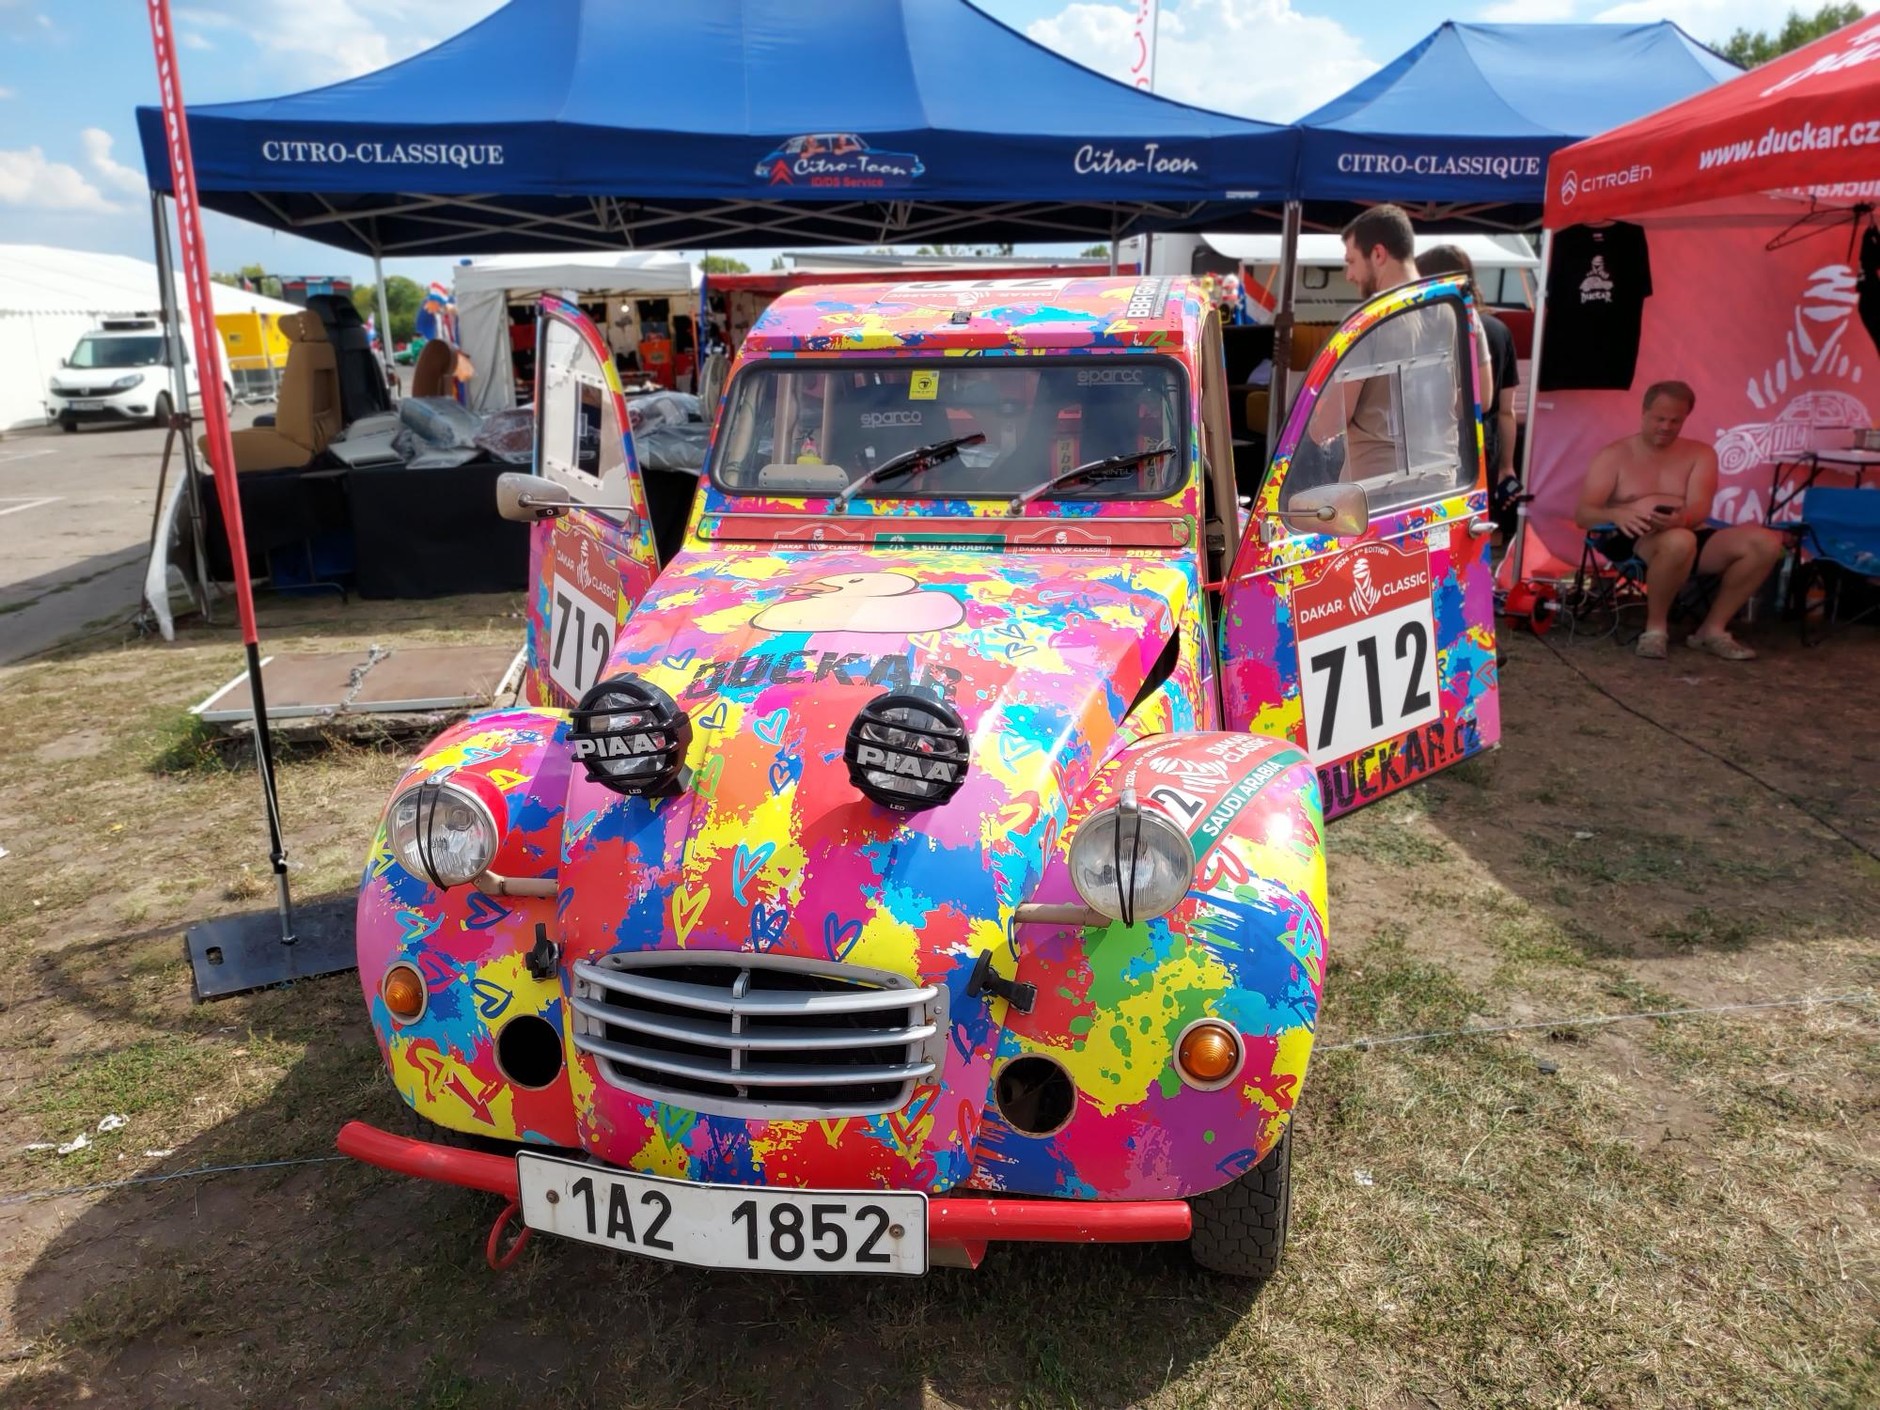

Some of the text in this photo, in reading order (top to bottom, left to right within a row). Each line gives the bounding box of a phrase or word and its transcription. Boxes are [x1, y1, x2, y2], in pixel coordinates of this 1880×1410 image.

[262, 141, 504, 169] CITRO-CLASSIQUE
[1074, 143, 1198, 174] Citro-Toon
[1698, 121, 1880, 170] www.duckar.cz
[793, 156, 907, 176] Citro-Toon
[843, 176, 884, 187] Service
[1337, 153, 1540, 179] CITRO-CLASSIQUE
[1364, 546, 1389, 556] EDITION
[592, 576, 616, 602] CLASSIC
[1300, 571, 1427, 624] DAKAR CLASSIC
[553, 591, 609, 691] 712
[684, 649, 963, 702] DUCKAR
[1311, 620, 1431, 751] 712
[575, 733, 658, 758] PIAA
[856, 744, 952, 783] PIAA
[889, 803, 906, 812] LED
[1202, 760, 1285, 837] SAUDI ARABIA
[571, 1176, 892, 1264] 1A2 1852
